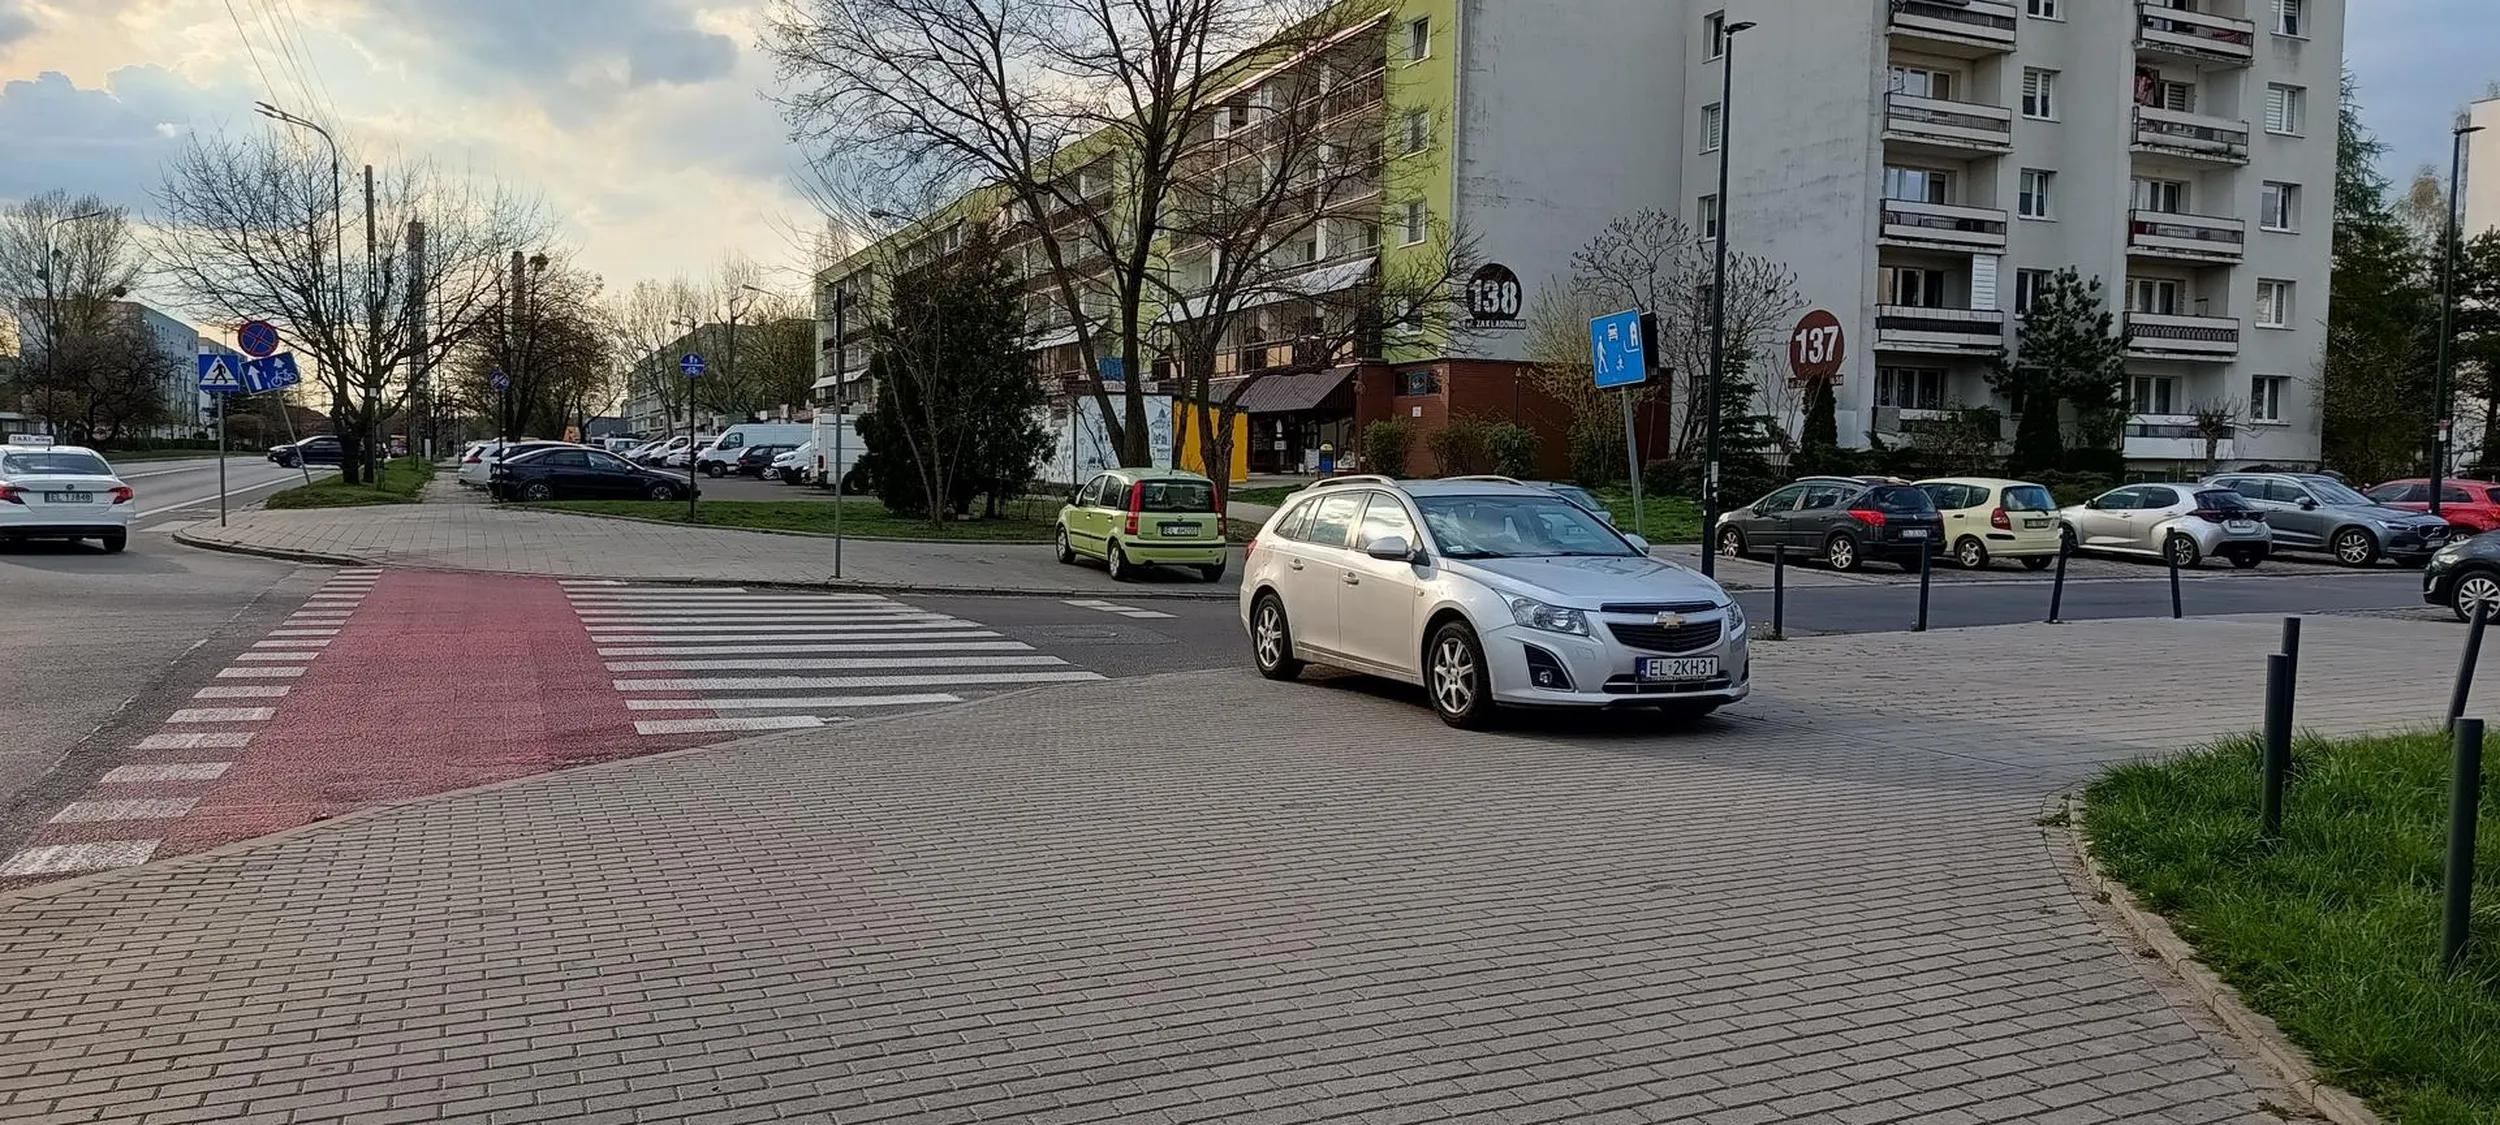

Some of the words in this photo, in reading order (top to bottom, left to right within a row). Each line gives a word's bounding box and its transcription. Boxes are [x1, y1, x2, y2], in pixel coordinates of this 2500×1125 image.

[1469, 280, 1517, 314] 138
[1795, 326, 1839, 363] 137
[1650, 660, 1667, 676] EL
[1673, 659, 1714, 676] 2KH31
